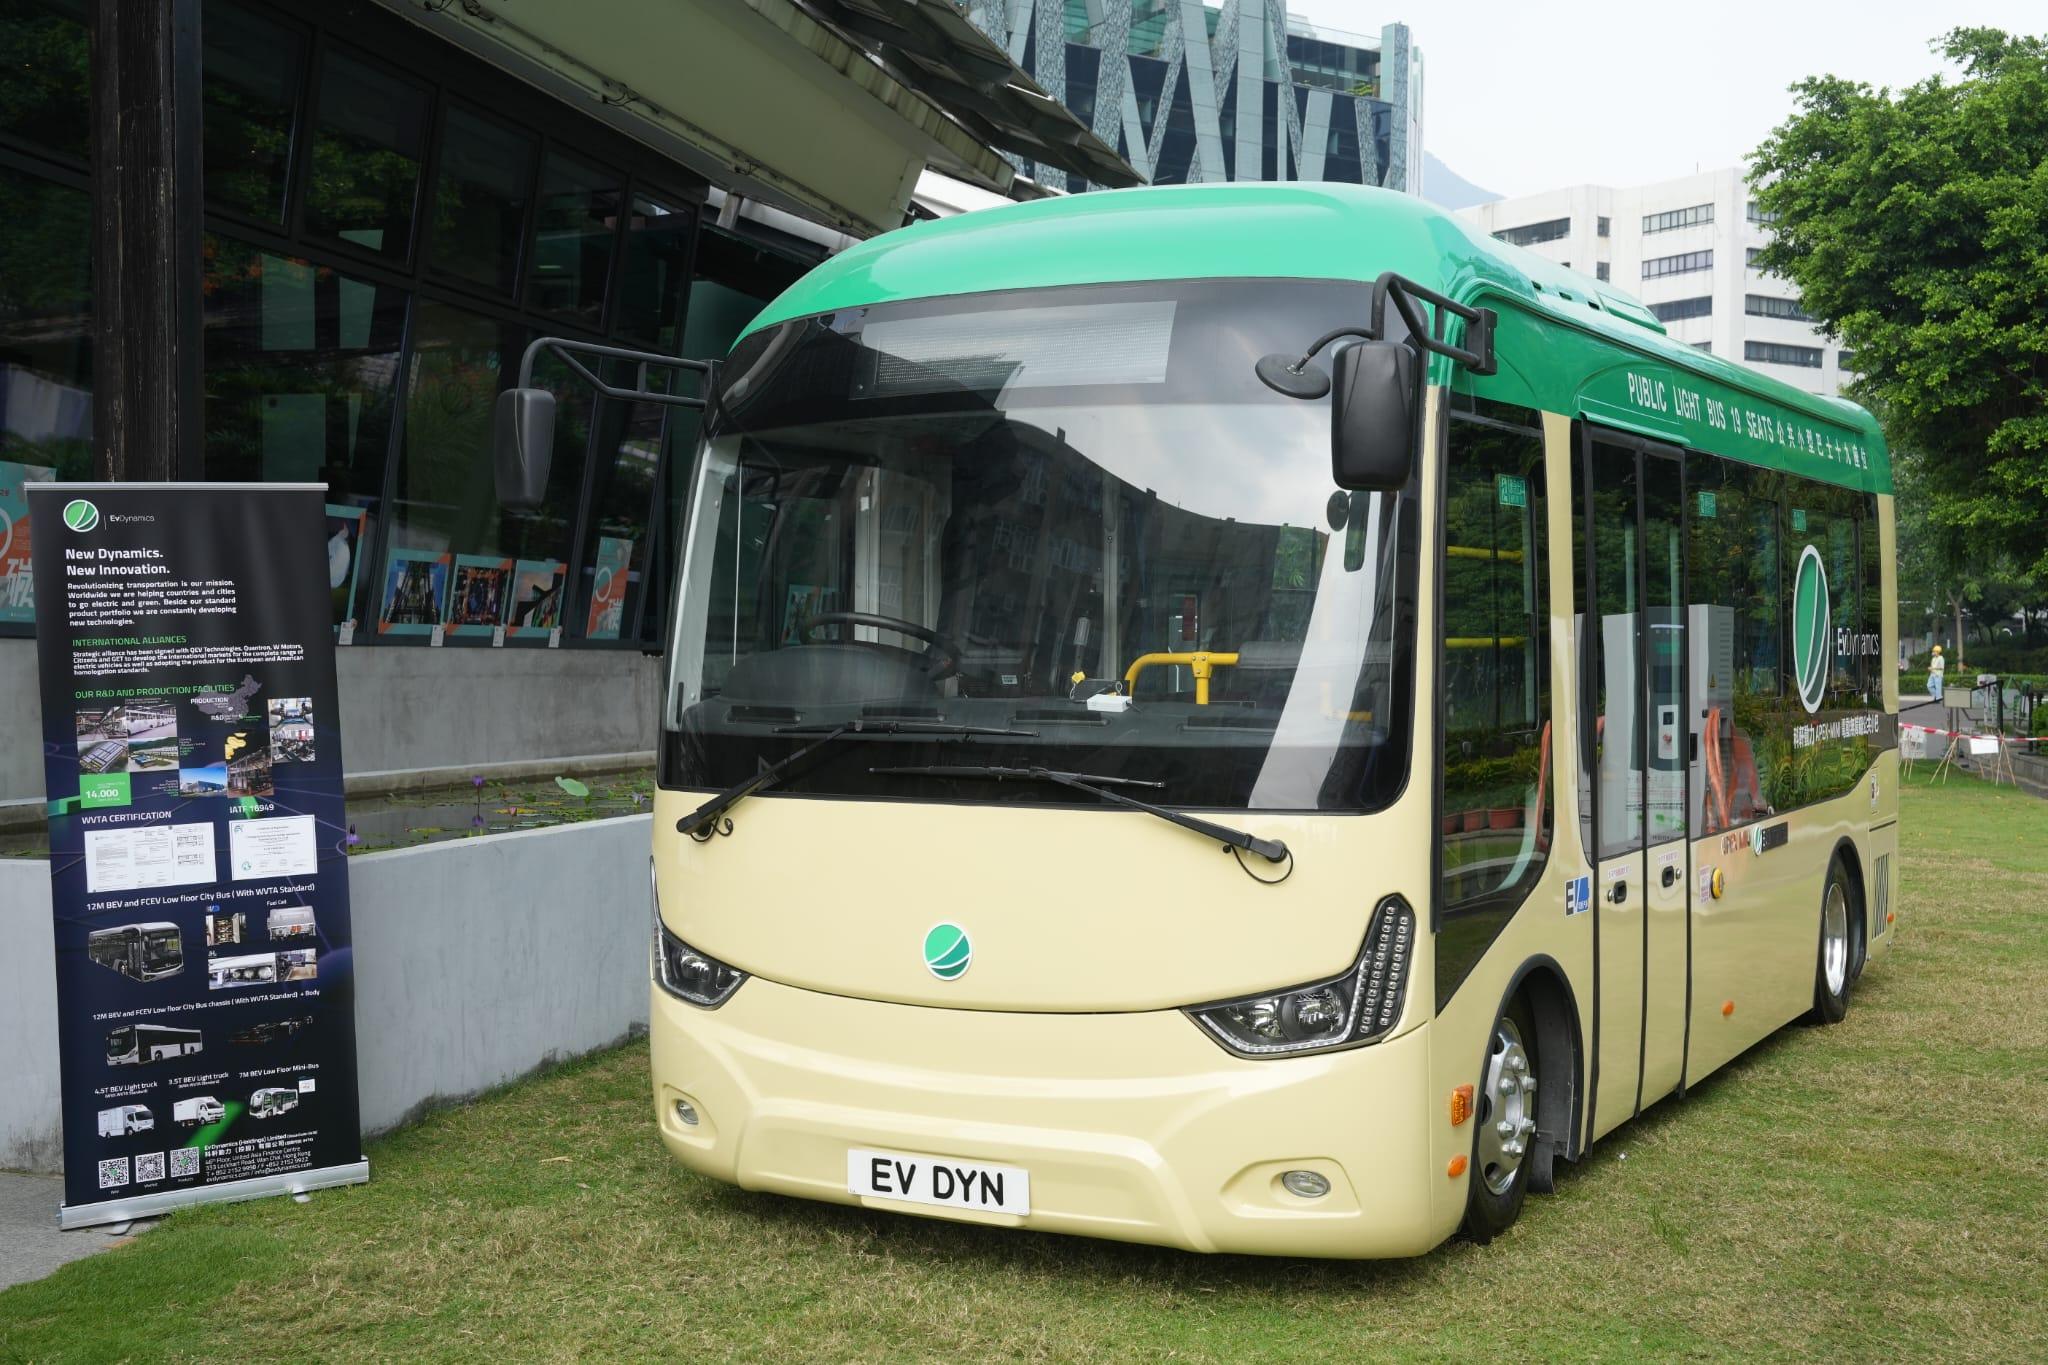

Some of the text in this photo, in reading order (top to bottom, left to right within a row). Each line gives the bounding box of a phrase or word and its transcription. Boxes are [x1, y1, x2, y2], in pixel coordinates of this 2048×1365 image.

[1627, 372, 1868, 470] PUBLIC LIGHT BUS 19 SEATS 公共小型巴士十九座位
[110, 514, 155, 523] EvDynamics
[66, 548, 163, 560] New Dynamics.
[67, 564, 170, 576] New Innovation.
[126, 581, 179, 589] transportation
[69, 609, 97, 618] product
[99, 608, 130, 617] portfolio
[159, 607, 196, 615] constantly
[198, 606, 237, 614] developing
[72, 636, 187, 647] INTERNATIONAL ALLIANCES
[1837, 627, 1880, 664] EvDynamics
[75, 684, 235, 699] OUR R&D AND PRODUCTION FACILITIES
[230, 804, 274, 814] IATF 16949
[82, 812, 172, 824] WVTA CERTIFICATION
[87, 902, 104, 911] 12M
[106, 901, 122, 910] BEV
[124, 899, 138, 908] and
[140, 897, 160, 906] FCEV
[199, 893, 214, 902] City
[236, 889, 254, 898] With
[255, 887, 278, 896] WVTA
[279, 884, 315, 894] Standard)
[269, 993, 298, 1002] Standard)
[872, 1157, 1004, 1206] EV DYN
